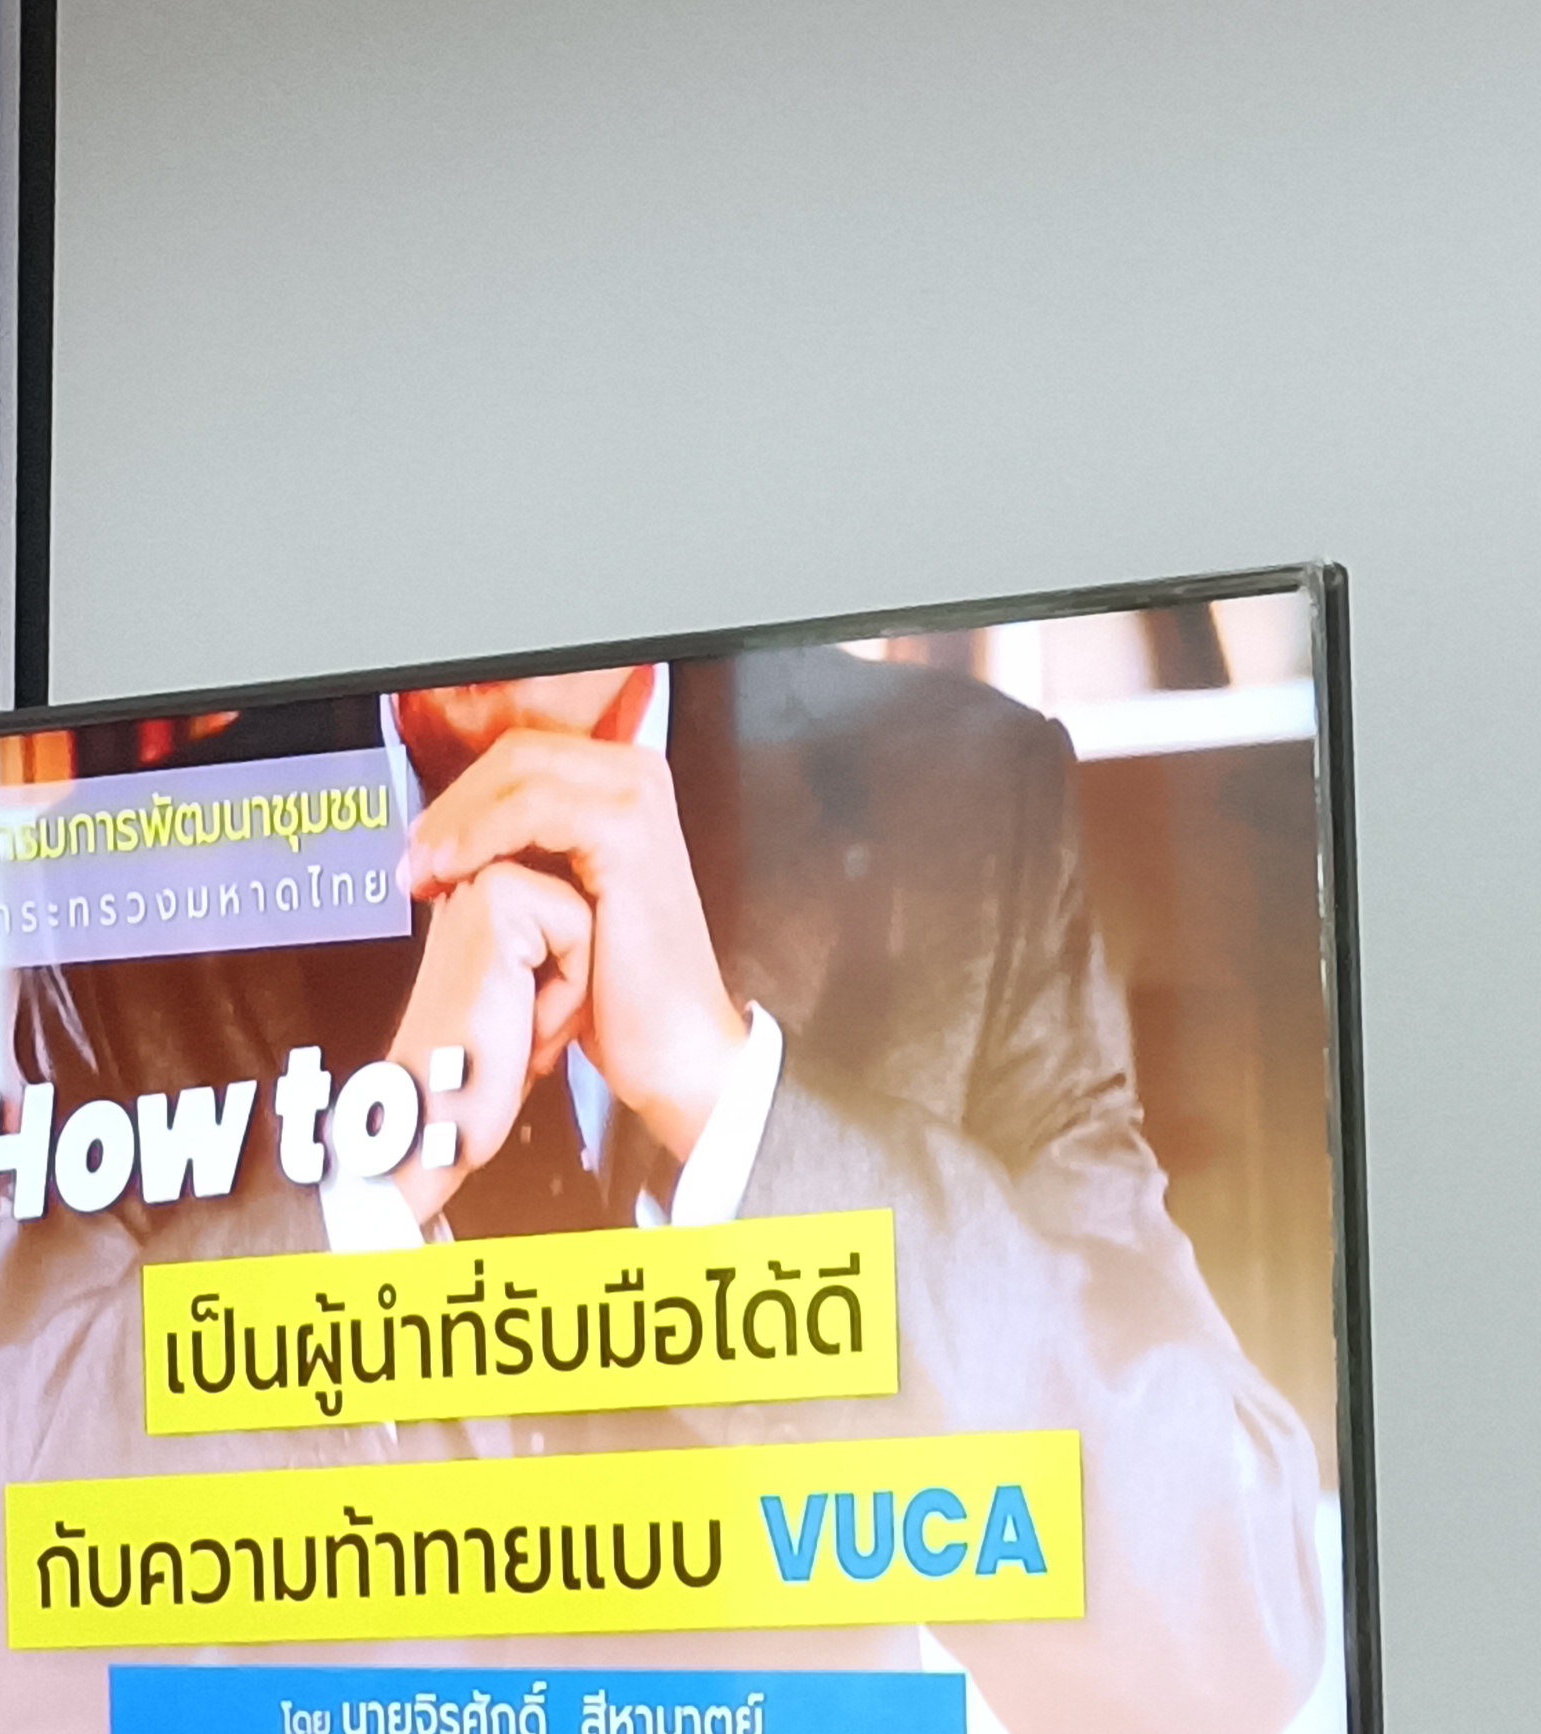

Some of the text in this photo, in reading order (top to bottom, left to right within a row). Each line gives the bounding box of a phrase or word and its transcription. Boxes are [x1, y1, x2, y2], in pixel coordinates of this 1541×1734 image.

[274, 1045, 465, 1187] to:
[164, 1251, 865, 1417] เป็นผู้นำที่รับมือได้ดี
[35, 1485, 1049, 1610] กับความท้าทายแบบ VUCA
